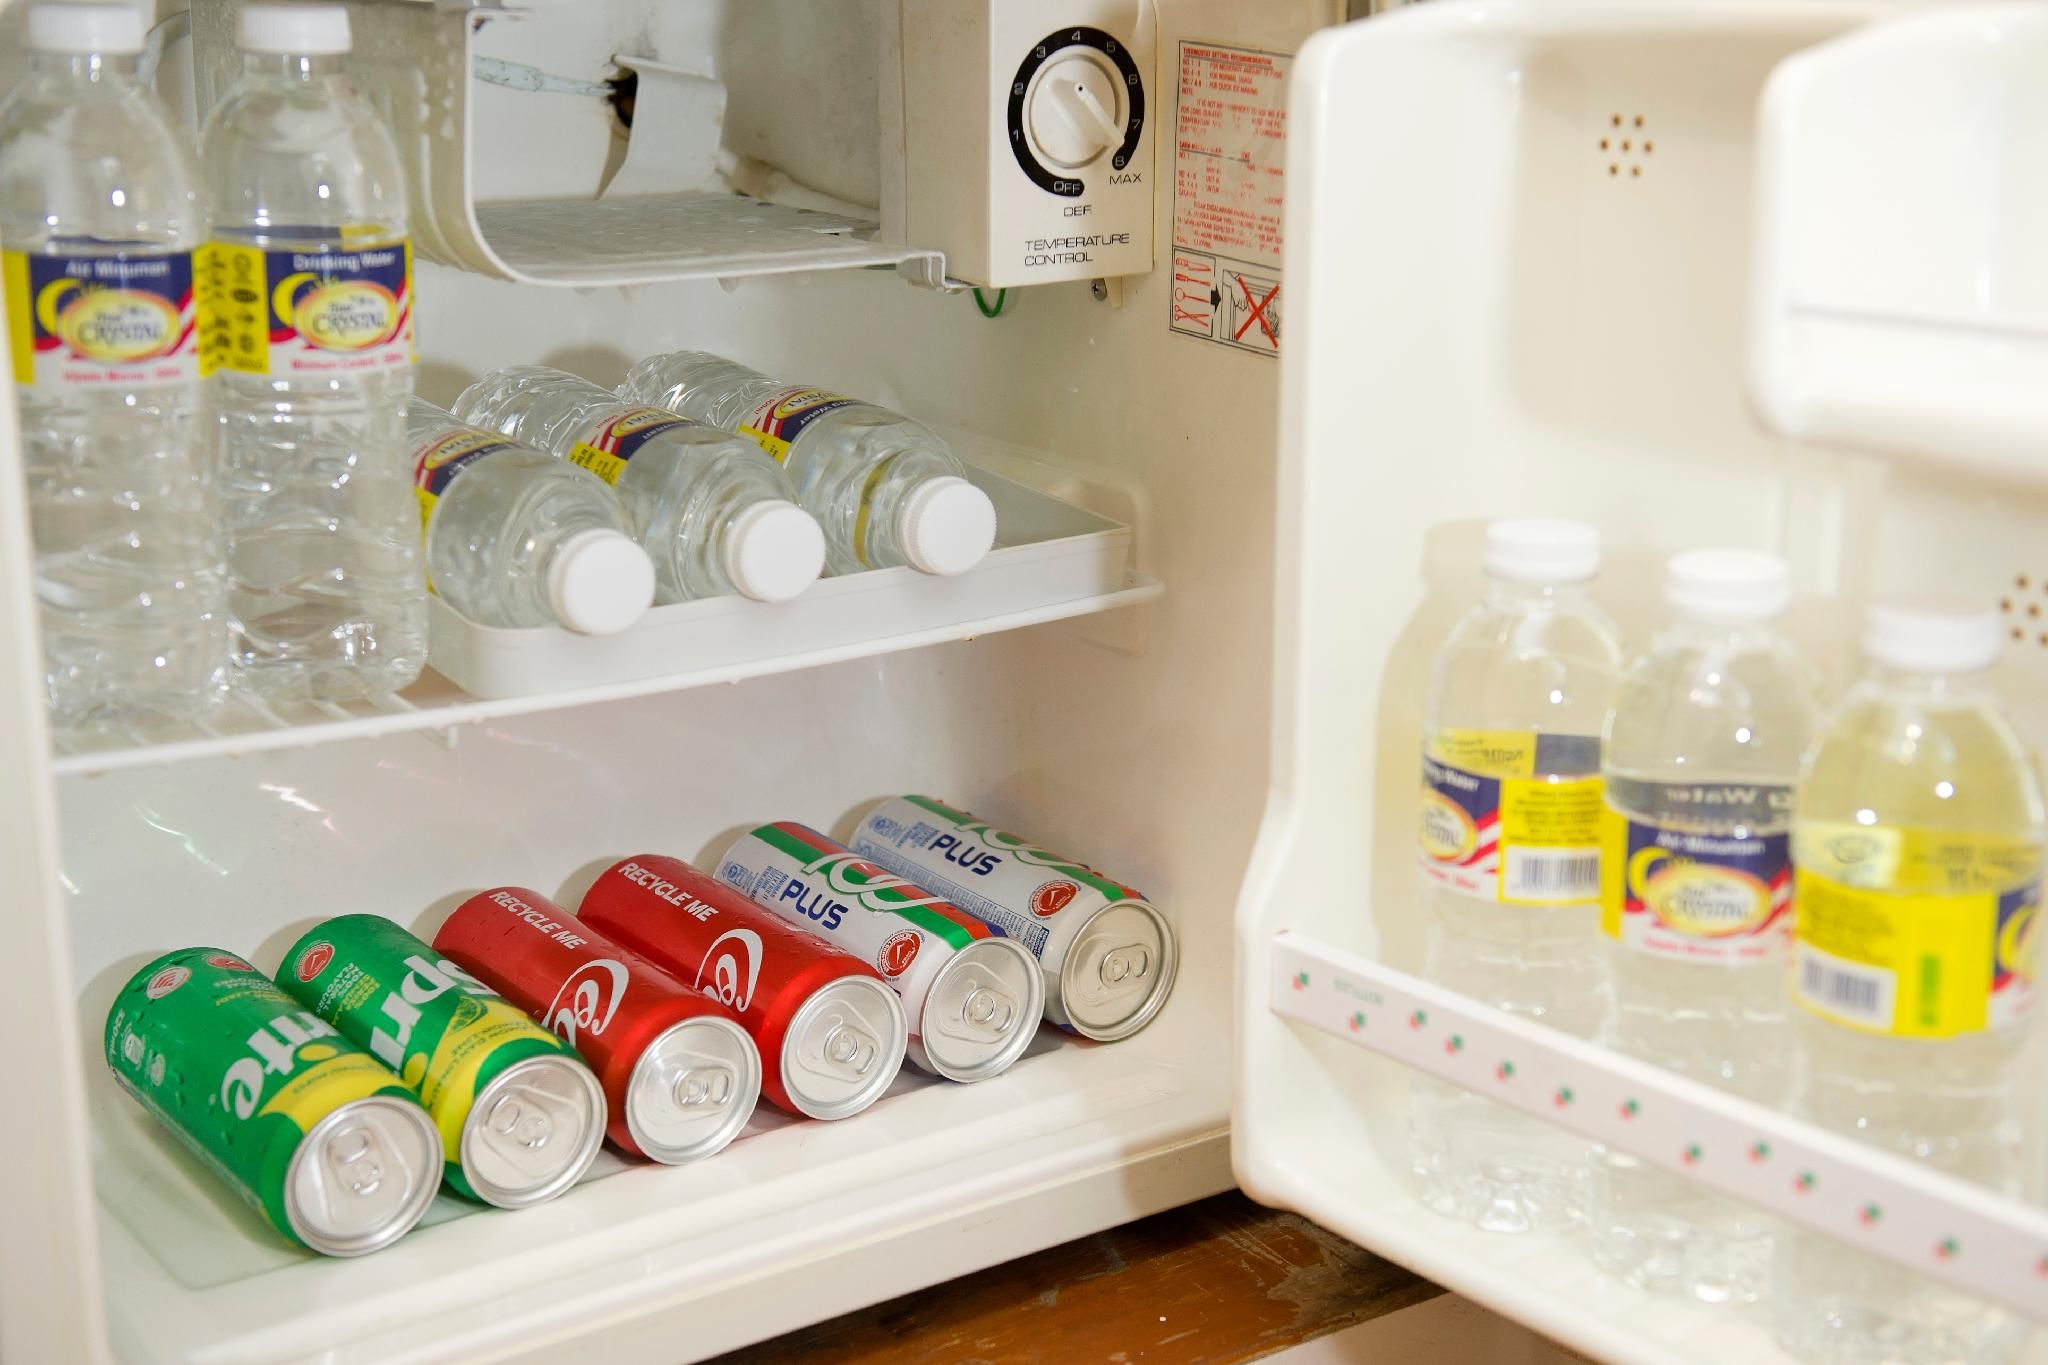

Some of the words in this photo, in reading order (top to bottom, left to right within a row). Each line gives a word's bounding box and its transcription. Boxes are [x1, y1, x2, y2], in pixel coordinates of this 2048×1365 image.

[1072, 30, 1081, 41] 4
[1036, 46, 1046, 58] 3
[1106, 41, 1116, 52] 5
[1129, 74, 1138, 84] 6
[1014, 82, 1024, 94] 2
[1132, 118, 1141, 129] 7
[1013, 129, 1019, 140] 1
[1116, 156, 1125, 167] 8
[1109, 174, 1142, 185] MAX
[1054, 180, 1081, 195] OFF
[1025, 233, 1130, 252] TEMPERATURE
[293, 254, 359, 274] Drinking
[362, 252, 395, 270] Water
[1024, 252, 1093, 267] CONTROL
[928, 833, 1002, 876] PLUS
[620, 862, 691, 908] RECYCLE
[683, 899, 719, 922] ME
[779, 878, 849, 931] PLUS
[488, 890, 560, 937] RECYCLE
[551, 926, 589, 951] ME
[316, 962, 355, 1014] FLAVOURS
[322, 966, 360, 1011] NATURAL
[221, 1011, 342, 1121] rite
